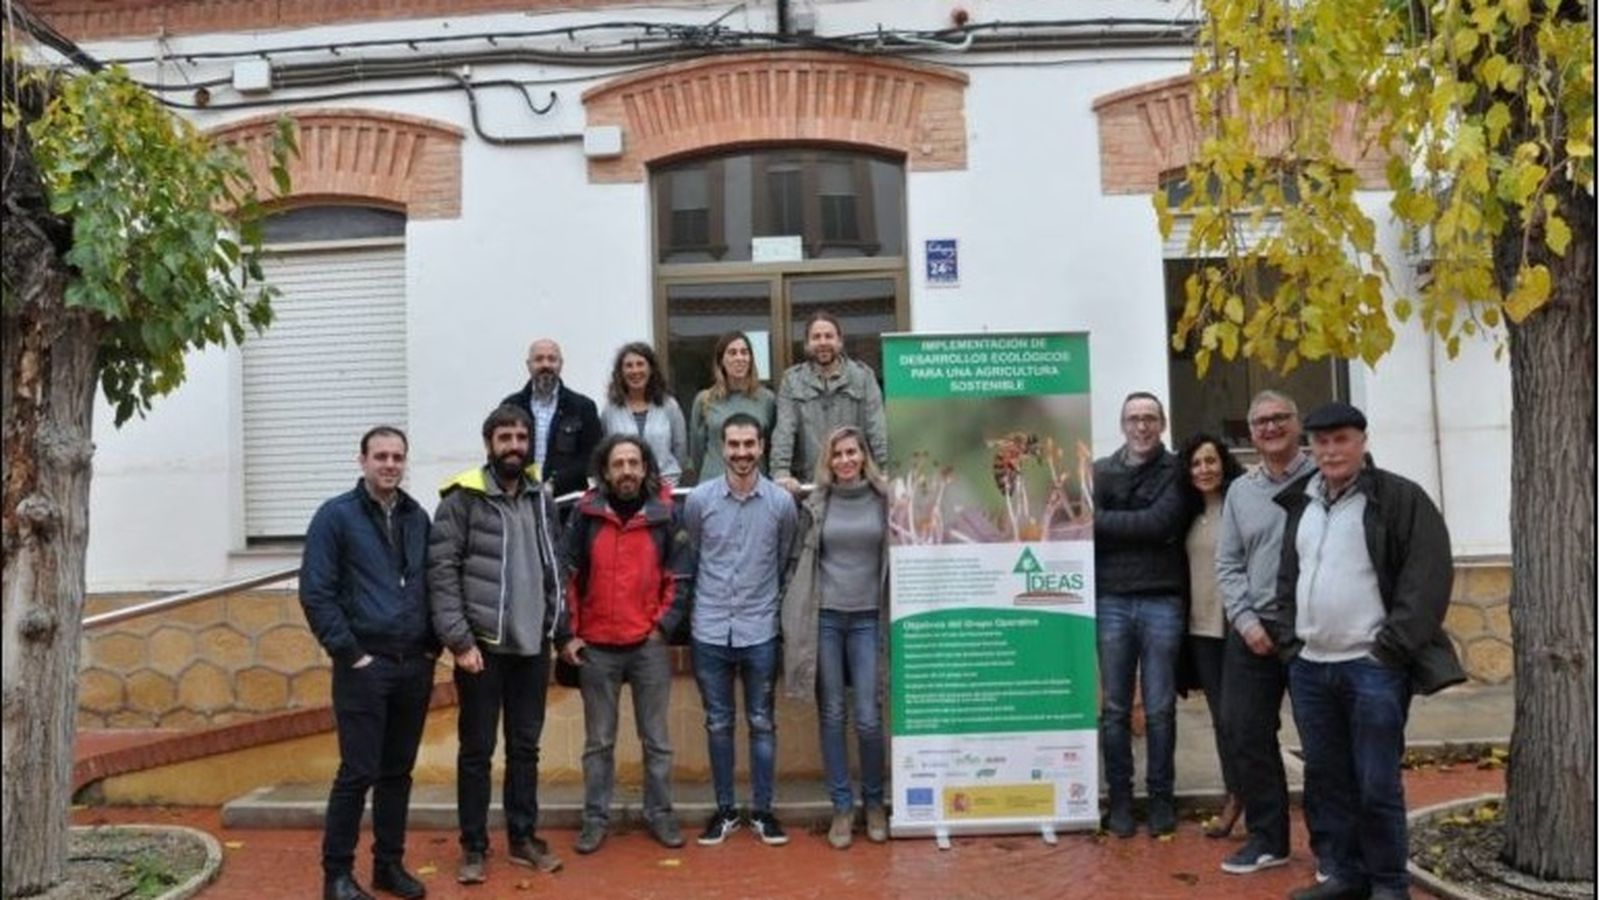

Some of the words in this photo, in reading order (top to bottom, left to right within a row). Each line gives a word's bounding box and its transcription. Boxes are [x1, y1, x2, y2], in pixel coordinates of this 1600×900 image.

[921, 338, 1028, 351] IMPLEMENTACIÓN
[1030, 338, 1047, 349] DE
[899, 352, 989, 366] DESARROLLOS
[990, 350, 1071, 364] ECOLÓGICOS
[911, 367, 944, 379] PARA
[945, 366, 975, 378] UNA
[976, 365, 1060, 377] AGRICULTURA
[950, 379, 1025, 392] SOSTENIBLE
